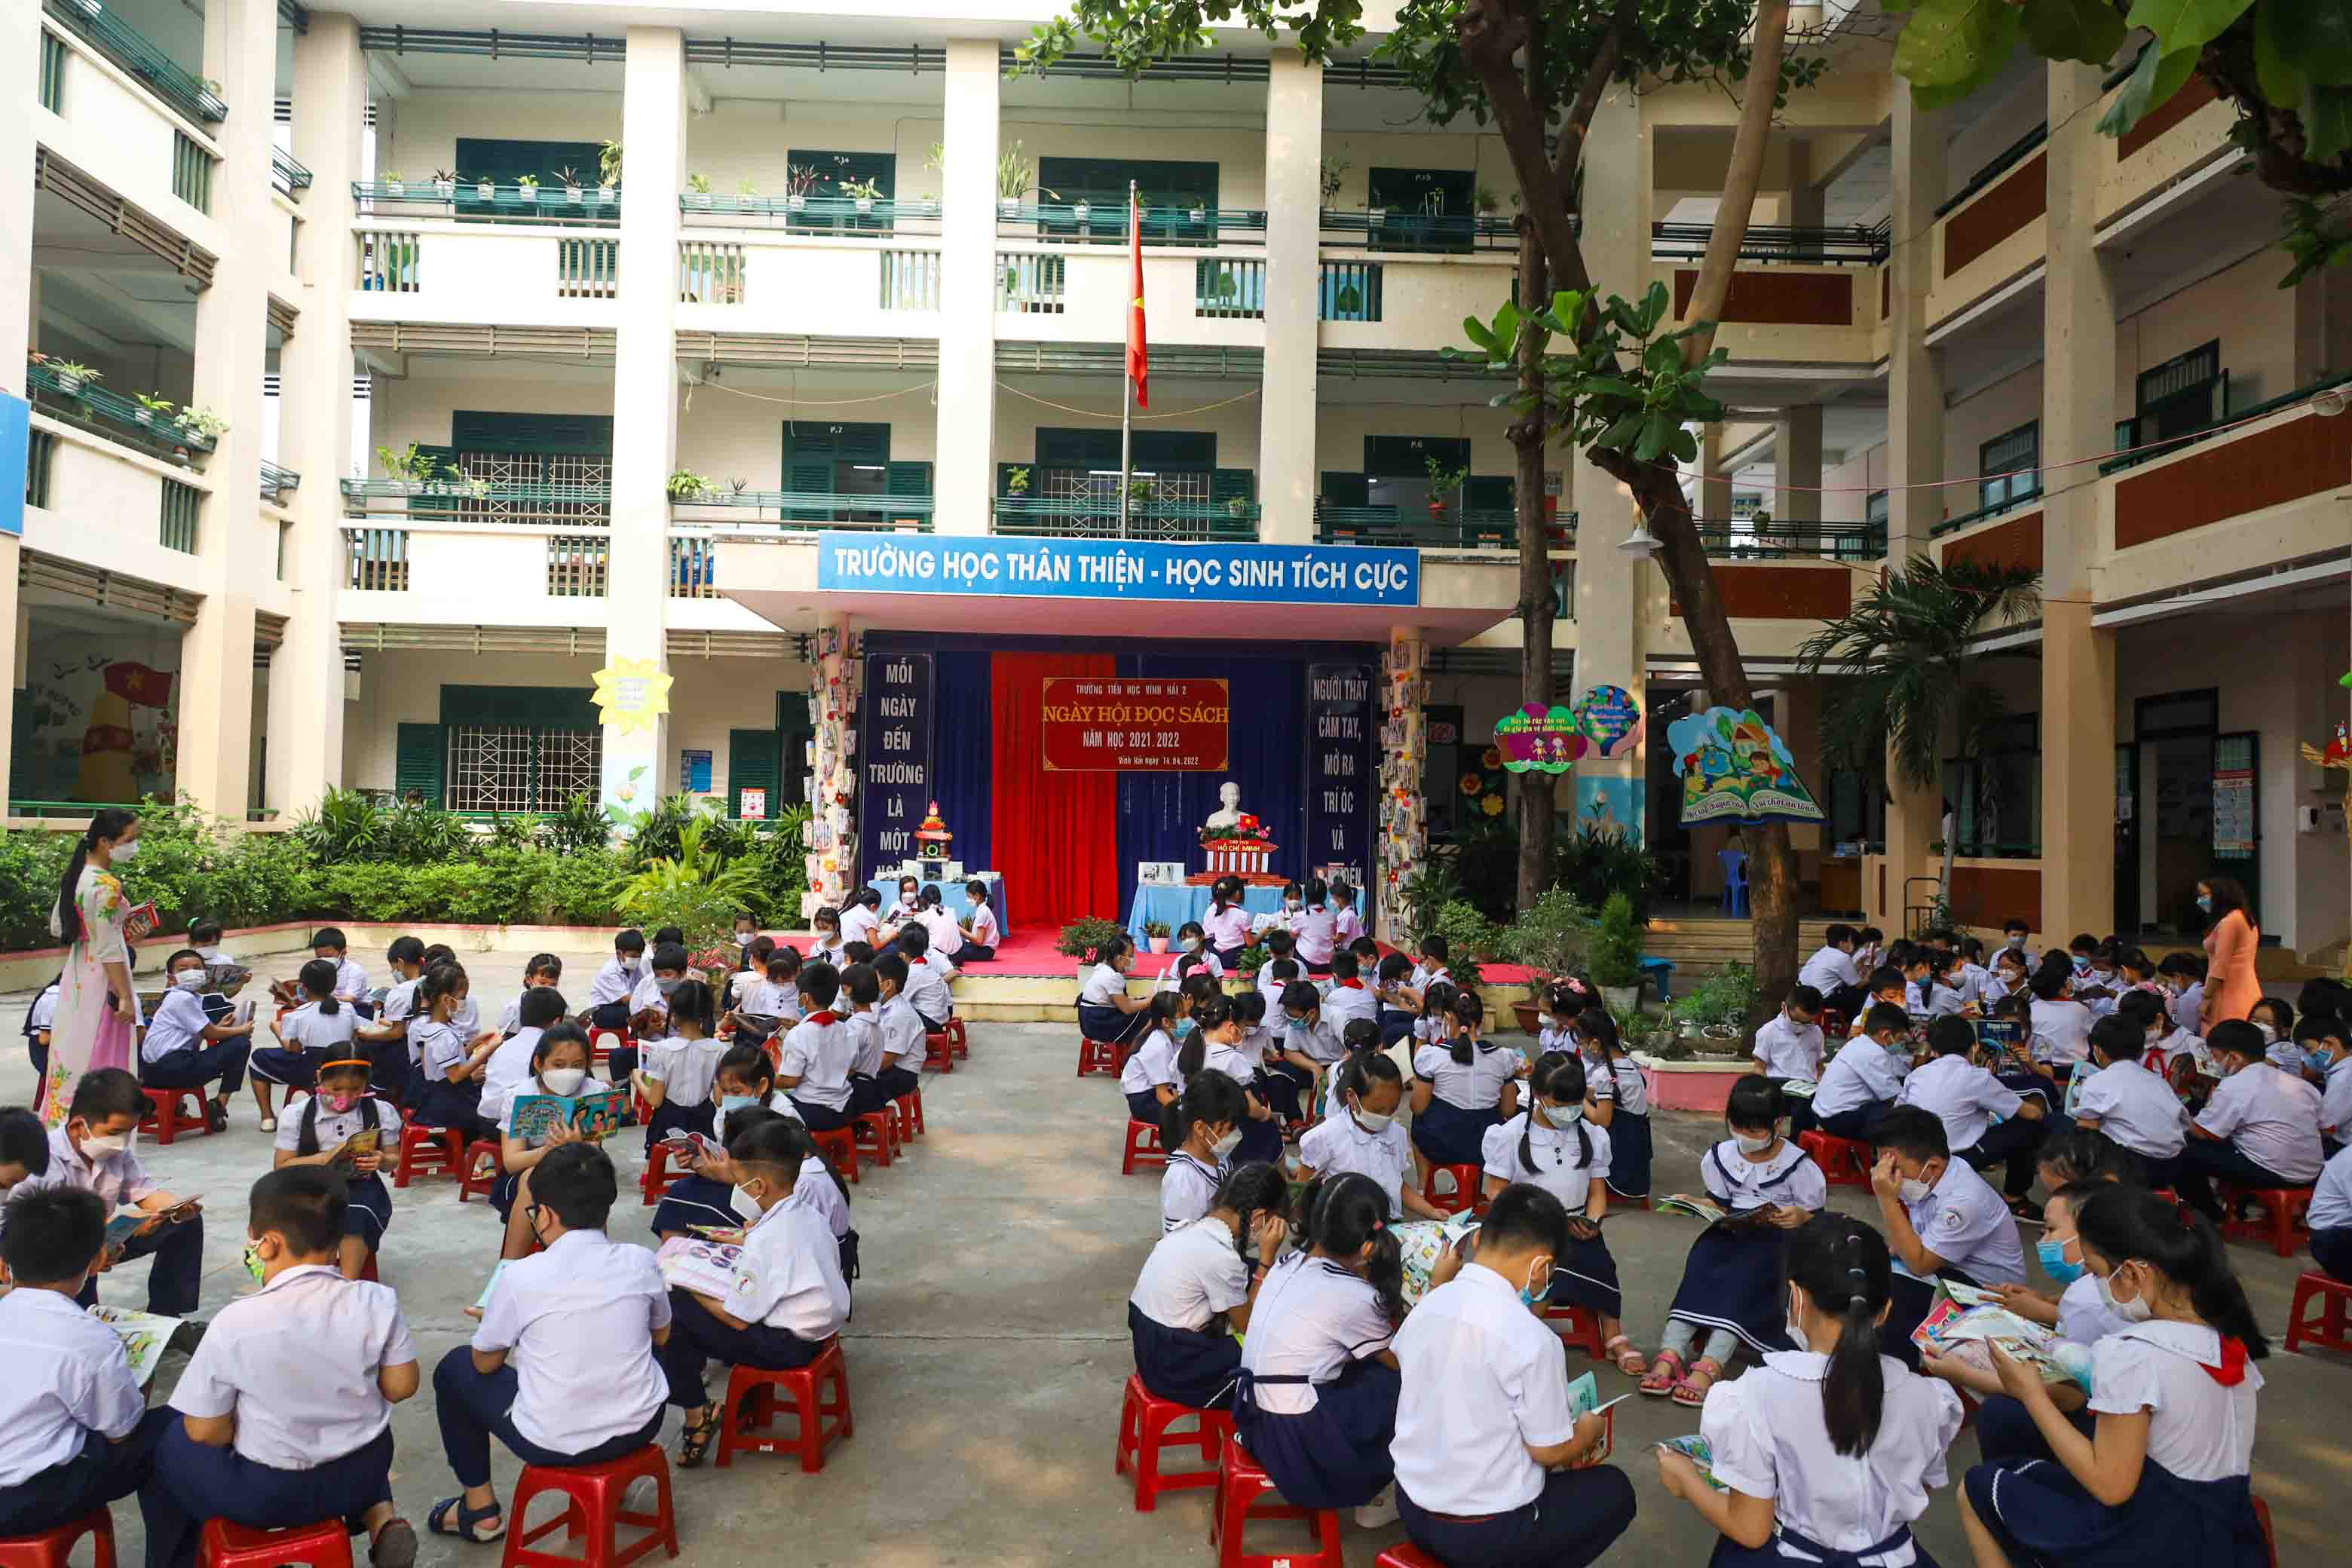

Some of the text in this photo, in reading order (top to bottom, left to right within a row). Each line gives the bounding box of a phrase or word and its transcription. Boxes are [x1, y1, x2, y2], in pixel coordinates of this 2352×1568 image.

[835, 542, 936, 579] TRƯỜNG
[943, 551, 1000, 587] HỌC
[1006, 547, 1070, 583] THÂN
[1078, 548, 1144, 592] THIỆN
[1165, 559, 1222, 593] HỌC
[1229, 559, 1283, 587] SINH
[1291, 553, 1346, 589] TÍCH
[1354, 559, 1409, 598] CỰC
[886, 657, 913, 684] MỖI
[1127, 685, 1141, 697] HỌC
[1182, 685, 1187, 694] 2
[1313, 675, 1342, 700] NGƯỜI
[880, 694, 917, 717] NGÀY
[1042, 701, 1230, 727] NGÀY HỘI ĐỌC SÁCH
[883, 724, 911, 750] ĐẾN
[1083, 729, 1103, 748] NĂM
[1107, 731, 1124, 750] HỌC
[1342, 717, 1361, 743] TAY,
[868, 761, 923, 784] TRƯỜNG
[1325, 748, 1355, 776] MỞ RA
[887, 793, 904, 817] LÀ
[1323, 786, 1354, 813] TRÍ ÓC
[880, 827, 911, 856] MỘT
[1332, 823, 1344, 850] VÀ
